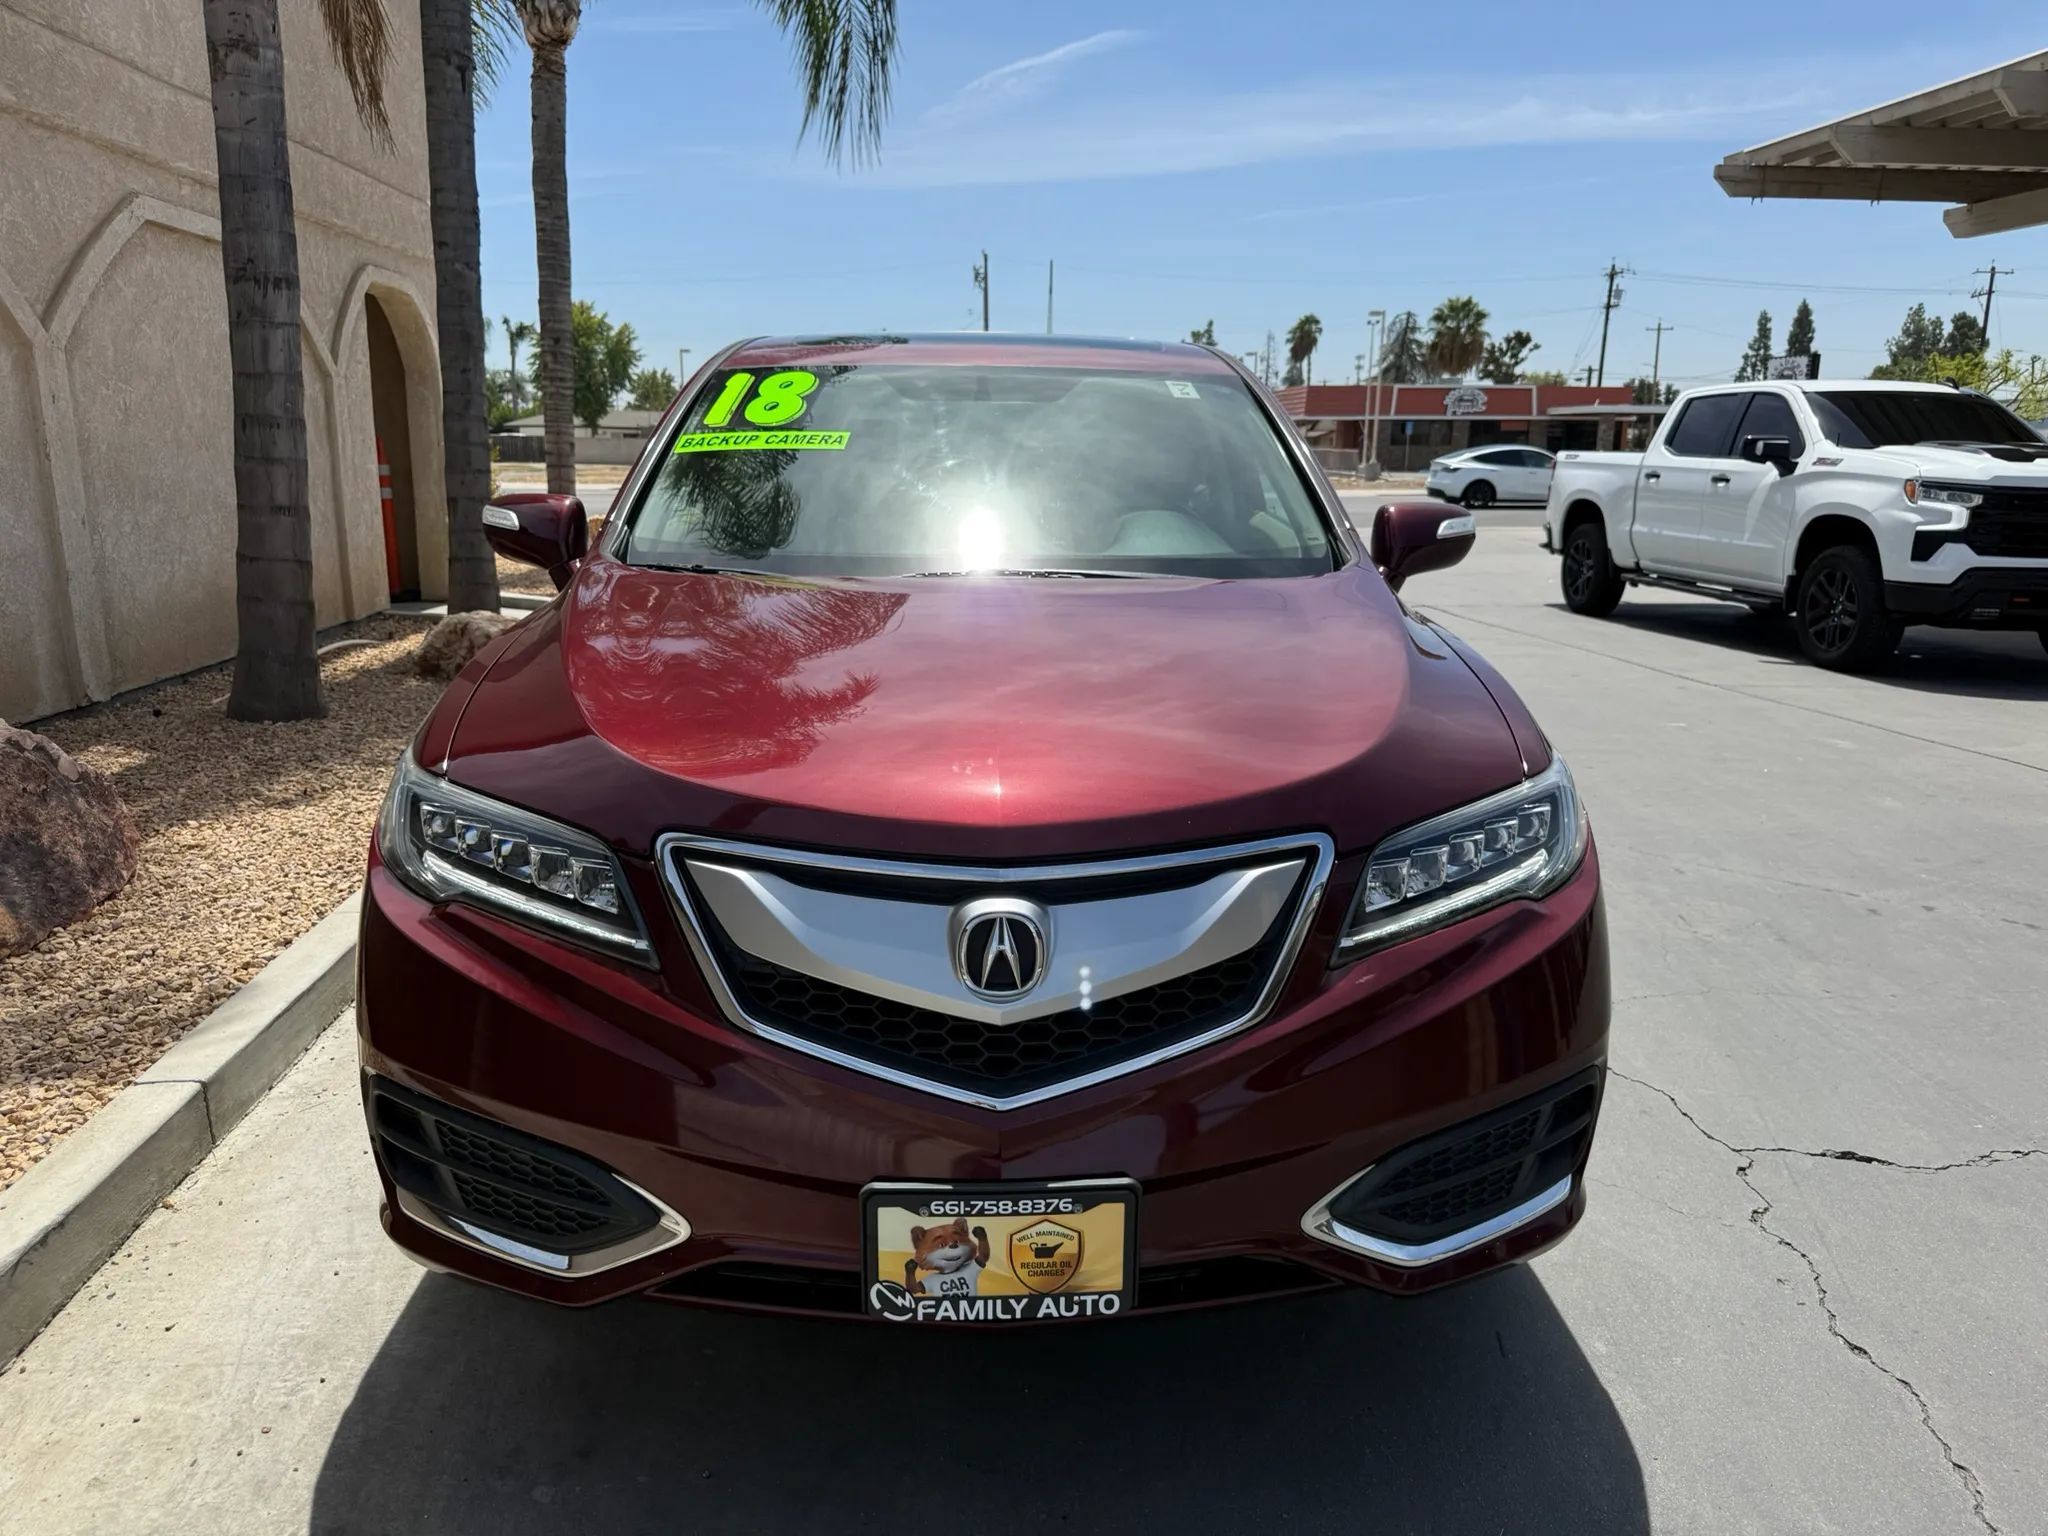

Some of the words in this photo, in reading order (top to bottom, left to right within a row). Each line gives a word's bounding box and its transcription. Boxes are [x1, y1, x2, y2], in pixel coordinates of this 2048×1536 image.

[703, 370, 819, 427] 18
[680, 434, 759, 449] BACKUP
[765, 433, 844, 446] CAMERA
[930, 1198, 1073, 1215] 661-758-8376
[1016, 1233, 1034, 1243] WELL
[1035, 1230, 1075, 1241] MAINTAINED
[1020, 1261, 1058, 1270] REGULAR
[1059, 1260, 1073, 1269] OIL
[1027, 1269, 1066, 1278] CHANGES
[940, 1276, 970, 1293] CAR
[917, 1298, 1029, 1321] FAMILY
[1036, 1293, 1121, 1319] AUTO
